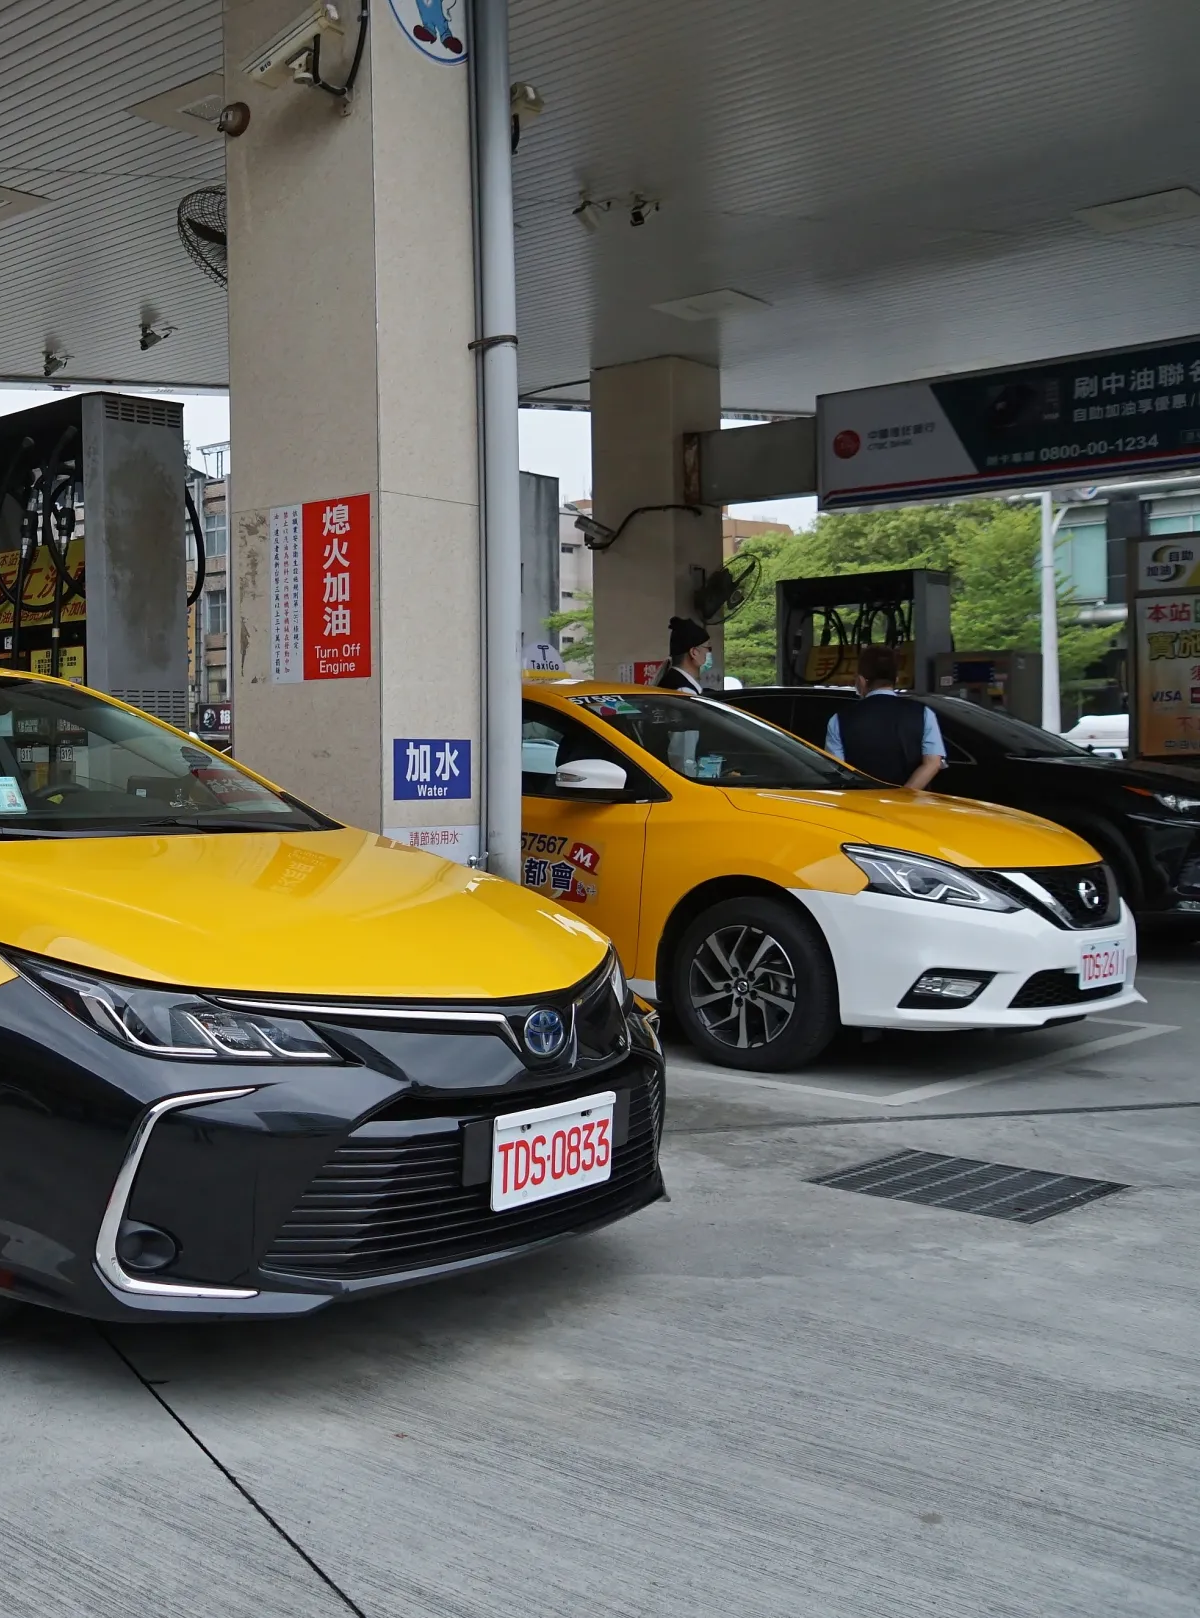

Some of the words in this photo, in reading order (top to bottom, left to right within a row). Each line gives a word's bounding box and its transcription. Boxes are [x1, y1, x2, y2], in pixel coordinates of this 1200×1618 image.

[1073, 393, 1200, 422] 自助加油享優惠/
[1040, 433, 1159, 461] 0800-00-1234
[322, 503, 350, 637] 熄火加油
[1147, 565, 1172, 577] 加油
[1147, 602, 1191, 622] 本站
[315, 645, 339, 659] Turn
[342, 643, 361, 657] Off
[319, 660, 356, 675] Engine
[531, 660, 560, 671] TaxiGo
[567, 694, 626, 705] 57567
[1151, 690, 1183, 702] VISA
[61, 747, 73, 760] 312
[405, 742, 460, 782] 加水
[417, 784, 449, 797] Water
[409, 831, 460, 848] 請節約用水
[524, 857, 577, 892] 都會
[497, 1118, 611, 1195] TDS-0833
